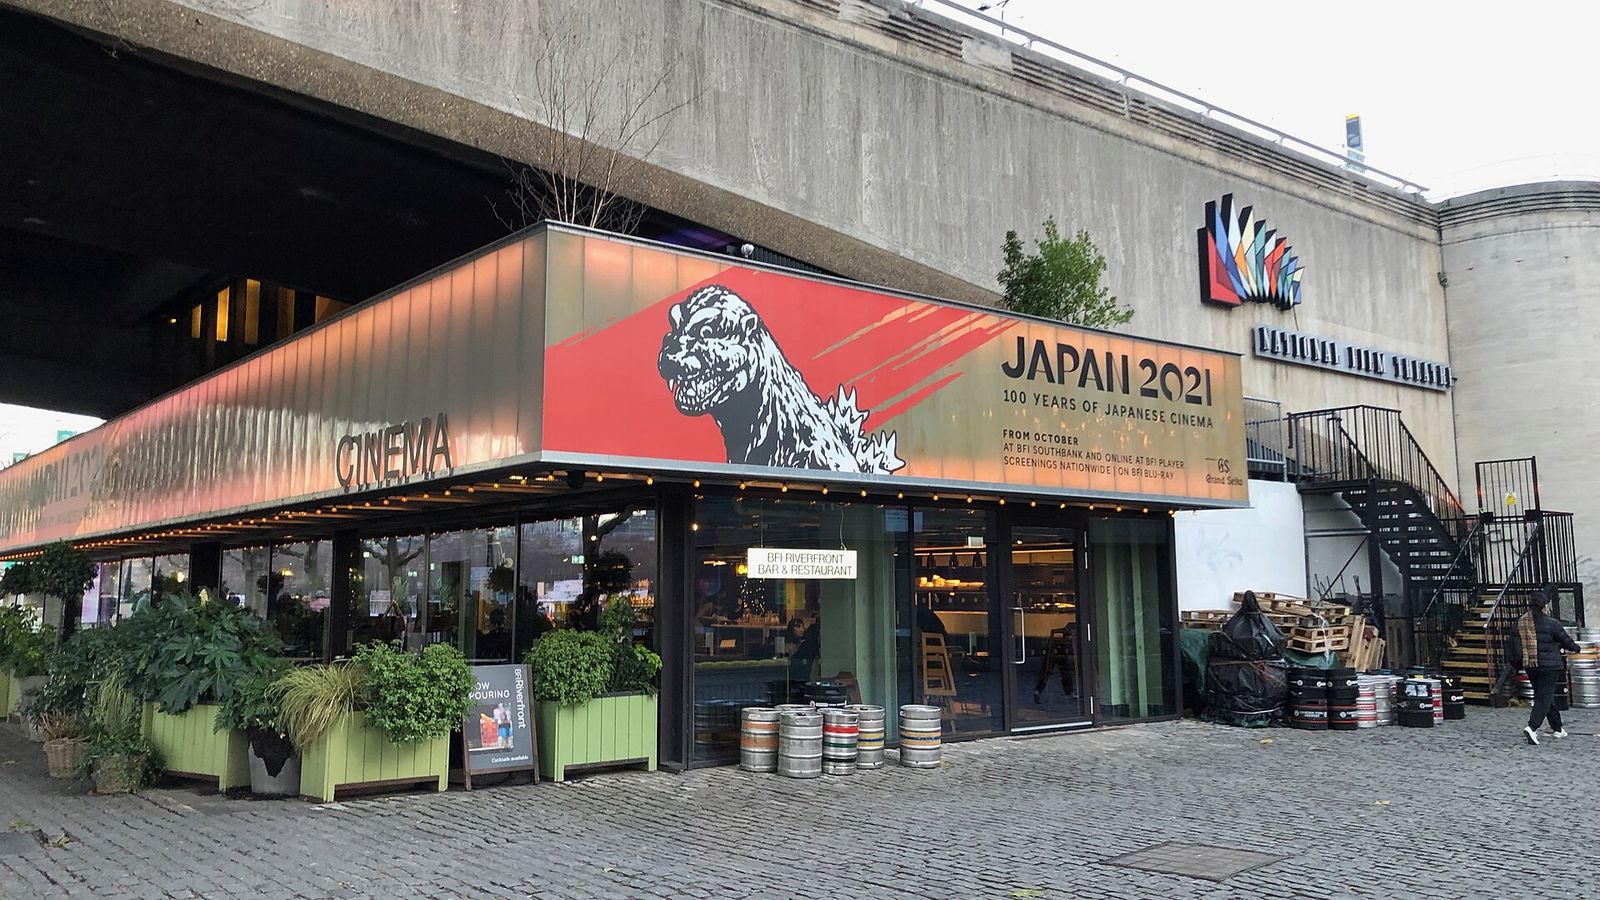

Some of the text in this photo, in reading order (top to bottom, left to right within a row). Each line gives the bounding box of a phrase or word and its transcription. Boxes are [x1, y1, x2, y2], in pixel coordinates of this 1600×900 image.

[1001, 336, 1212, 406] JAPAN 2021
[1003, 389, 1213, 429] 100 YEARS OF JAPANESE CINEMA
[1003, 429, 1079, 446] FROM OCTOBER
[336, 412, 452, 491] CINEMA
[1003, 442, 1185, 470] AT BFI SOUTHBANK AND ONLINE AT BFI PLAYER
[1003, 456, 1175, 481] SCREENINGS NATIONWIDE ON BFI BLU-RAY
[766, 552, 845, 564] BFI RIVERFRONT
[757, 564, 779, 575] BAR
[781, 565, 788, 574] &
[790, 565, 853, 576] RESTAURANT
[468, 689, 511, 700] POURING
[474, 681, 490, 691] OW
